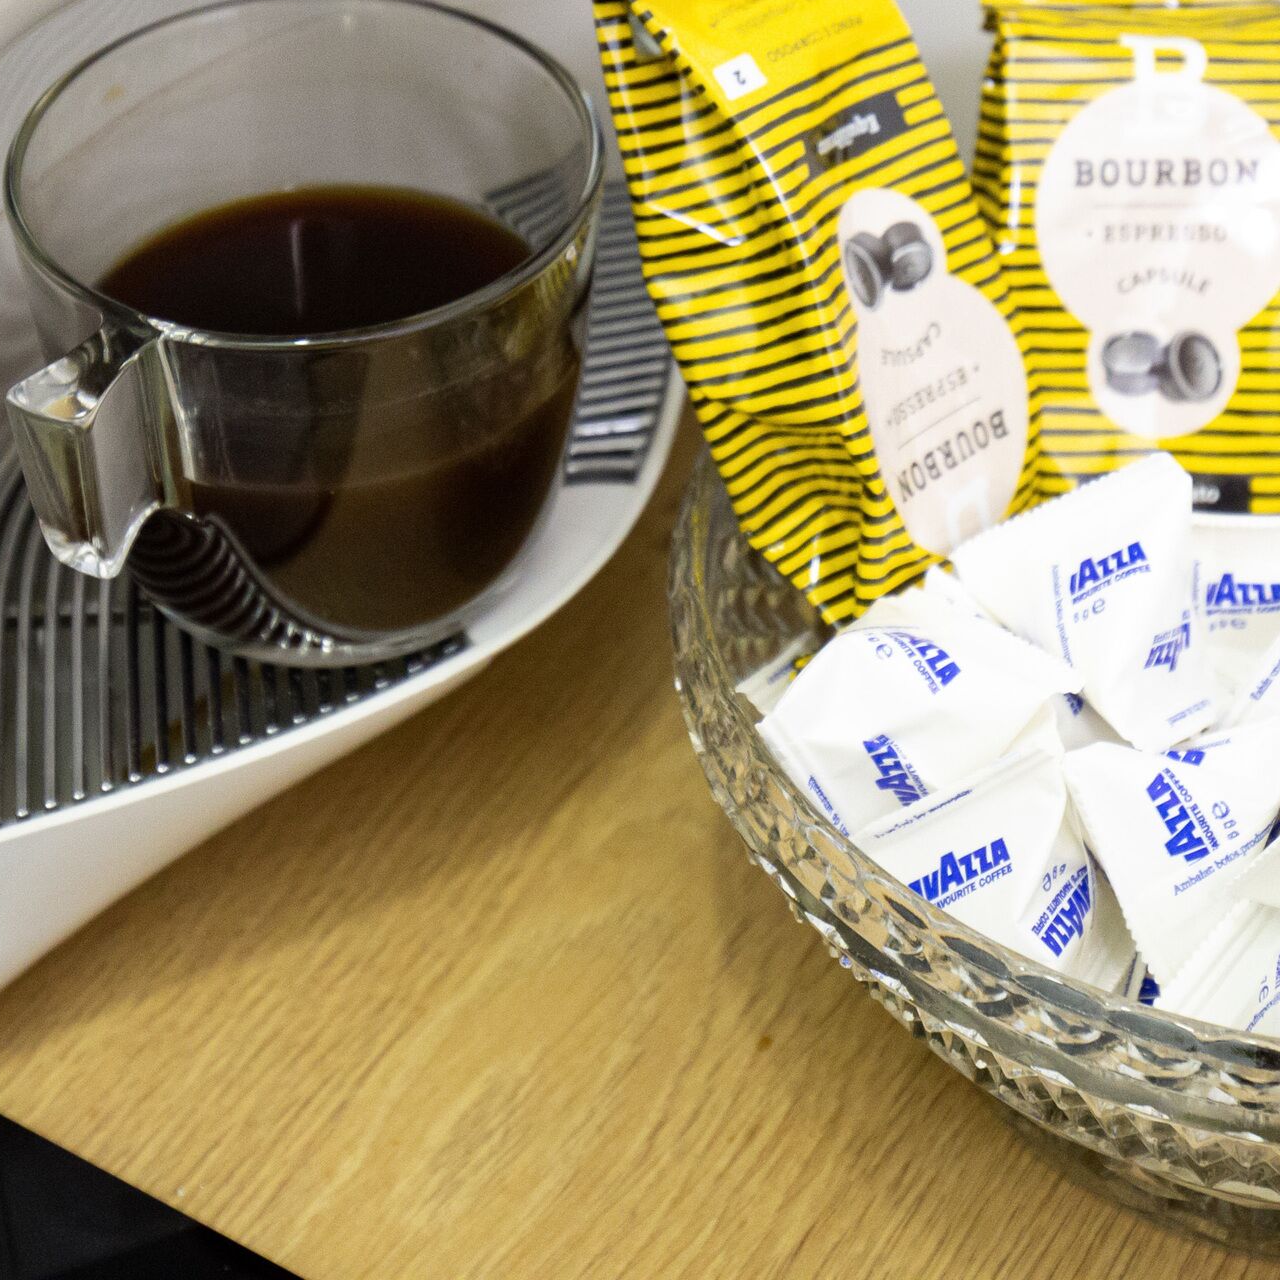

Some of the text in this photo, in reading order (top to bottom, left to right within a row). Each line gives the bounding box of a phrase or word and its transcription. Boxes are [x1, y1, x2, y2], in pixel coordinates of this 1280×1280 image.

[1075, 159, 1262, 187] BOURBON
[898, 410, 1010, 503] BOURBON
[1162, 768, 1194, 806] COFFEE
[934, 863, 1013, 910] AVOURITE COFFEE
